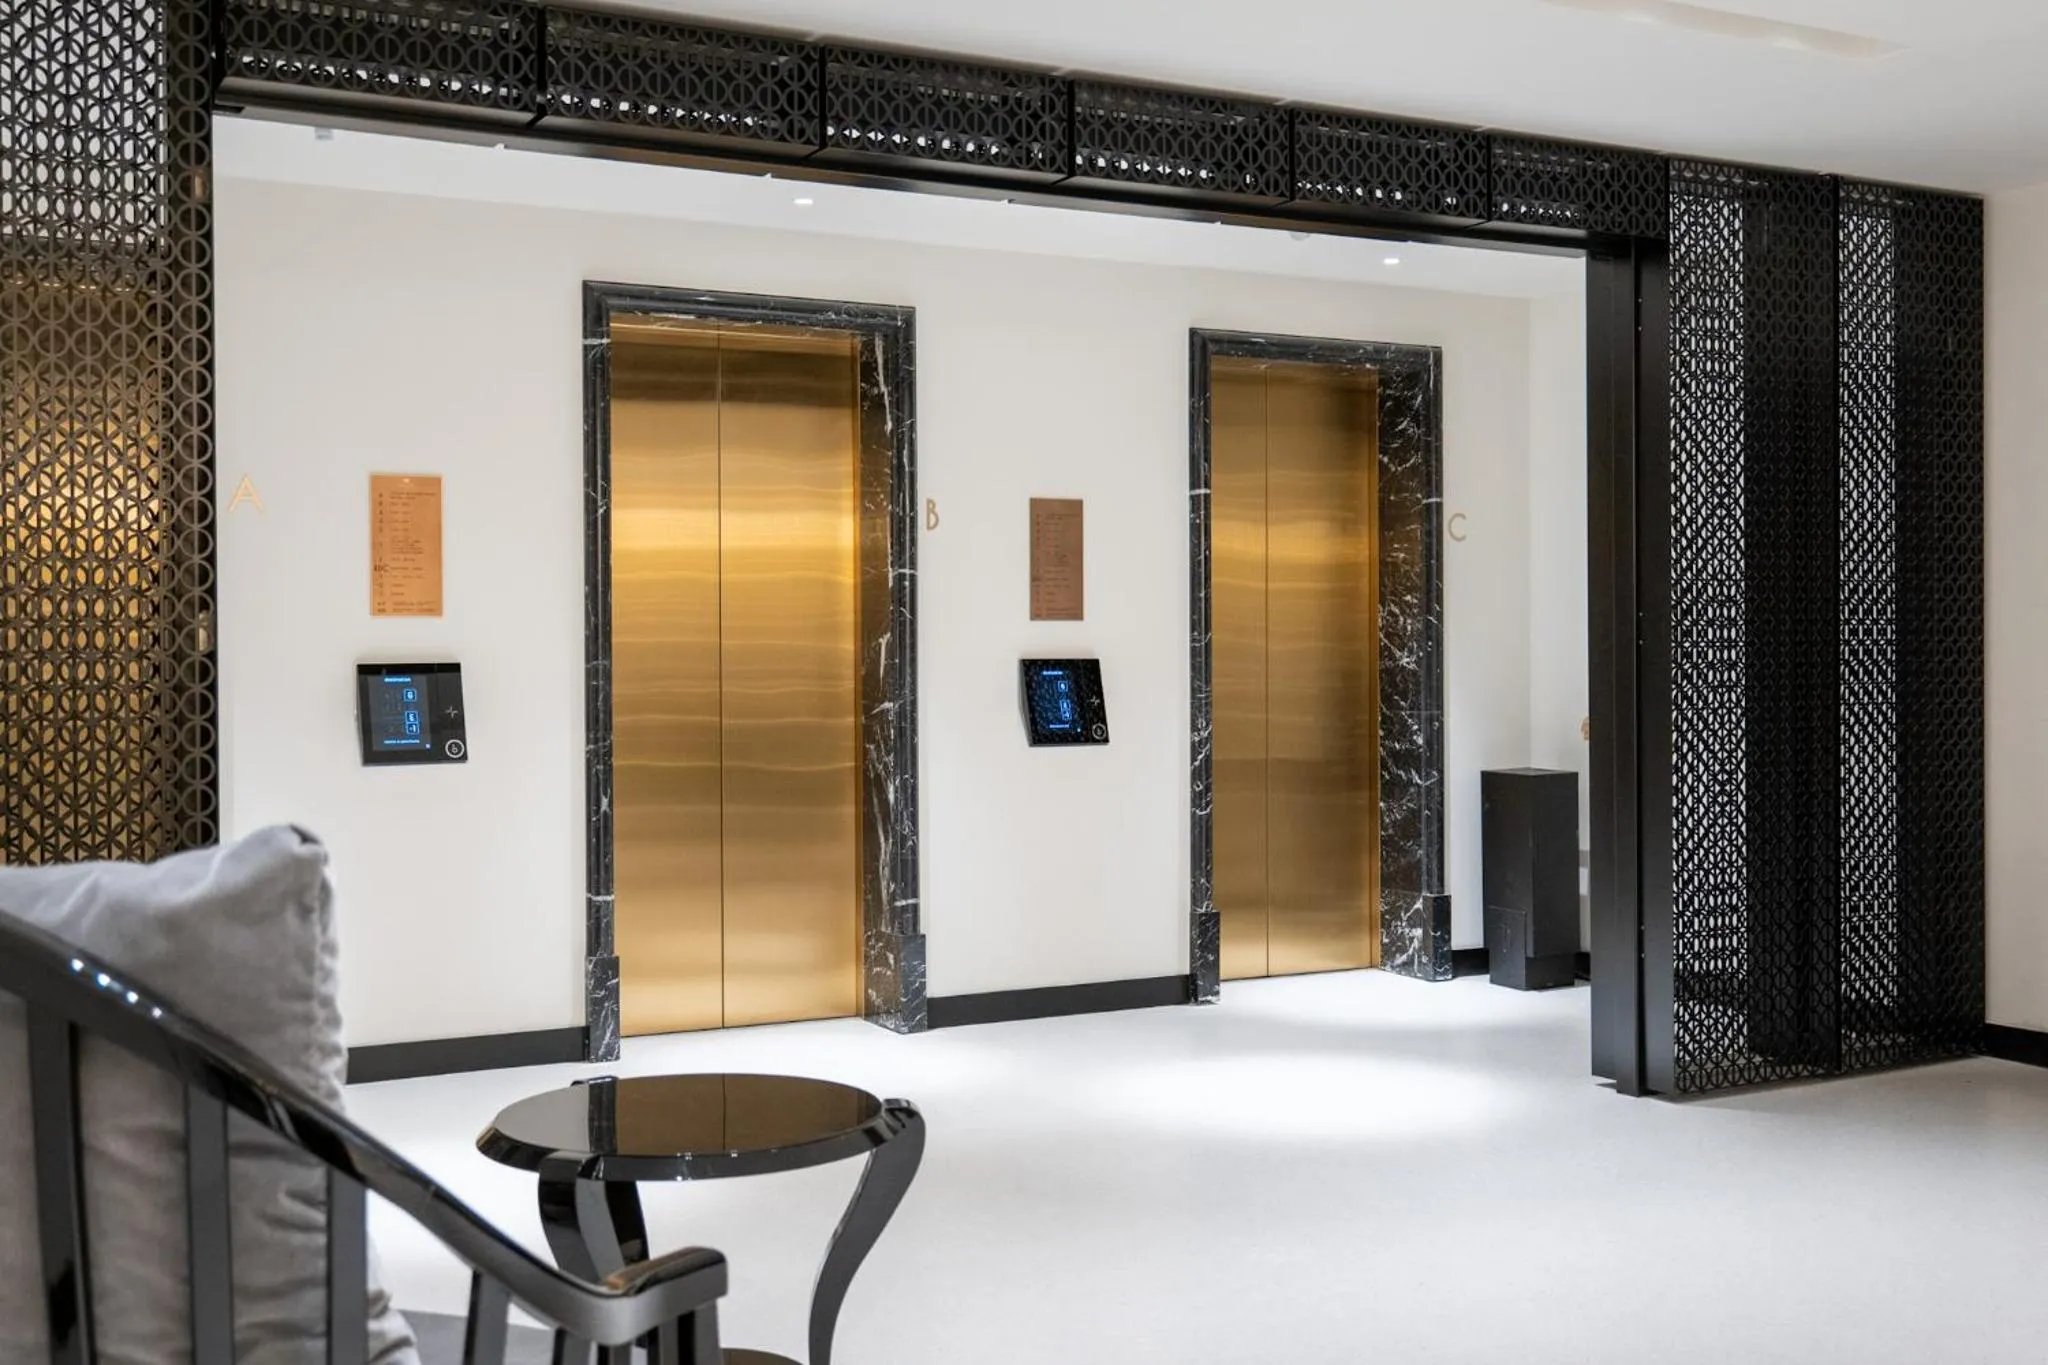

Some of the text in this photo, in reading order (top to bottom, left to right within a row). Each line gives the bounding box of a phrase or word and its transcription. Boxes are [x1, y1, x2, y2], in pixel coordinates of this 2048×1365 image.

[228, 475, 265, 513] A
[926, 498, 940, 531] B
[1448, 512, 1467, 542] C
